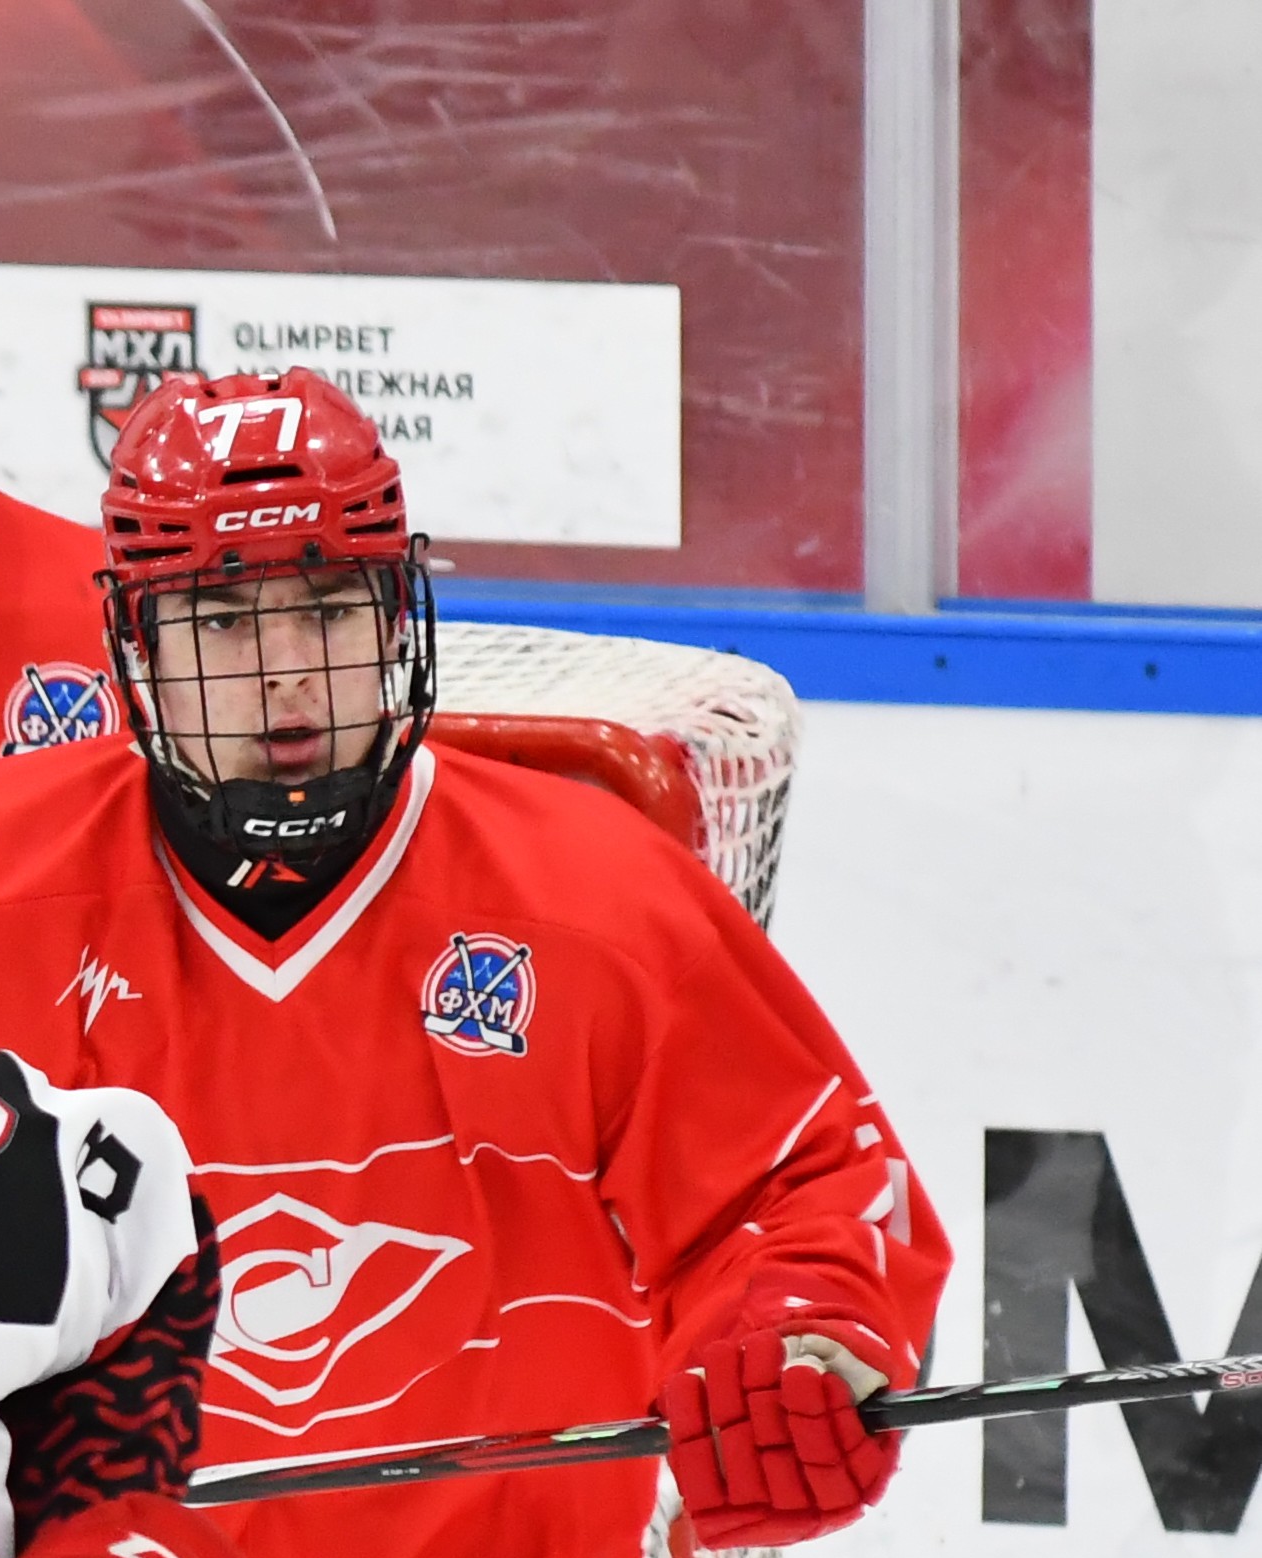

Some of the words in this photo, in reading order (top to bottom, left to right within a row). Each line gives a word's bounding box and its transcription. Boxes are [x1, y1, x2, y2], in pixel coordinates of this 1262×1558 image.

[235, 322, 394, 354] OLIMPBET
[198, 397, 303, 461] 77
[215, 502, 321, 533] CCM
[21, 714, 101, 744] ФХМ
[243, 810, 346, 839] CCM
[439, 987, 515, 1028] ФХМ
